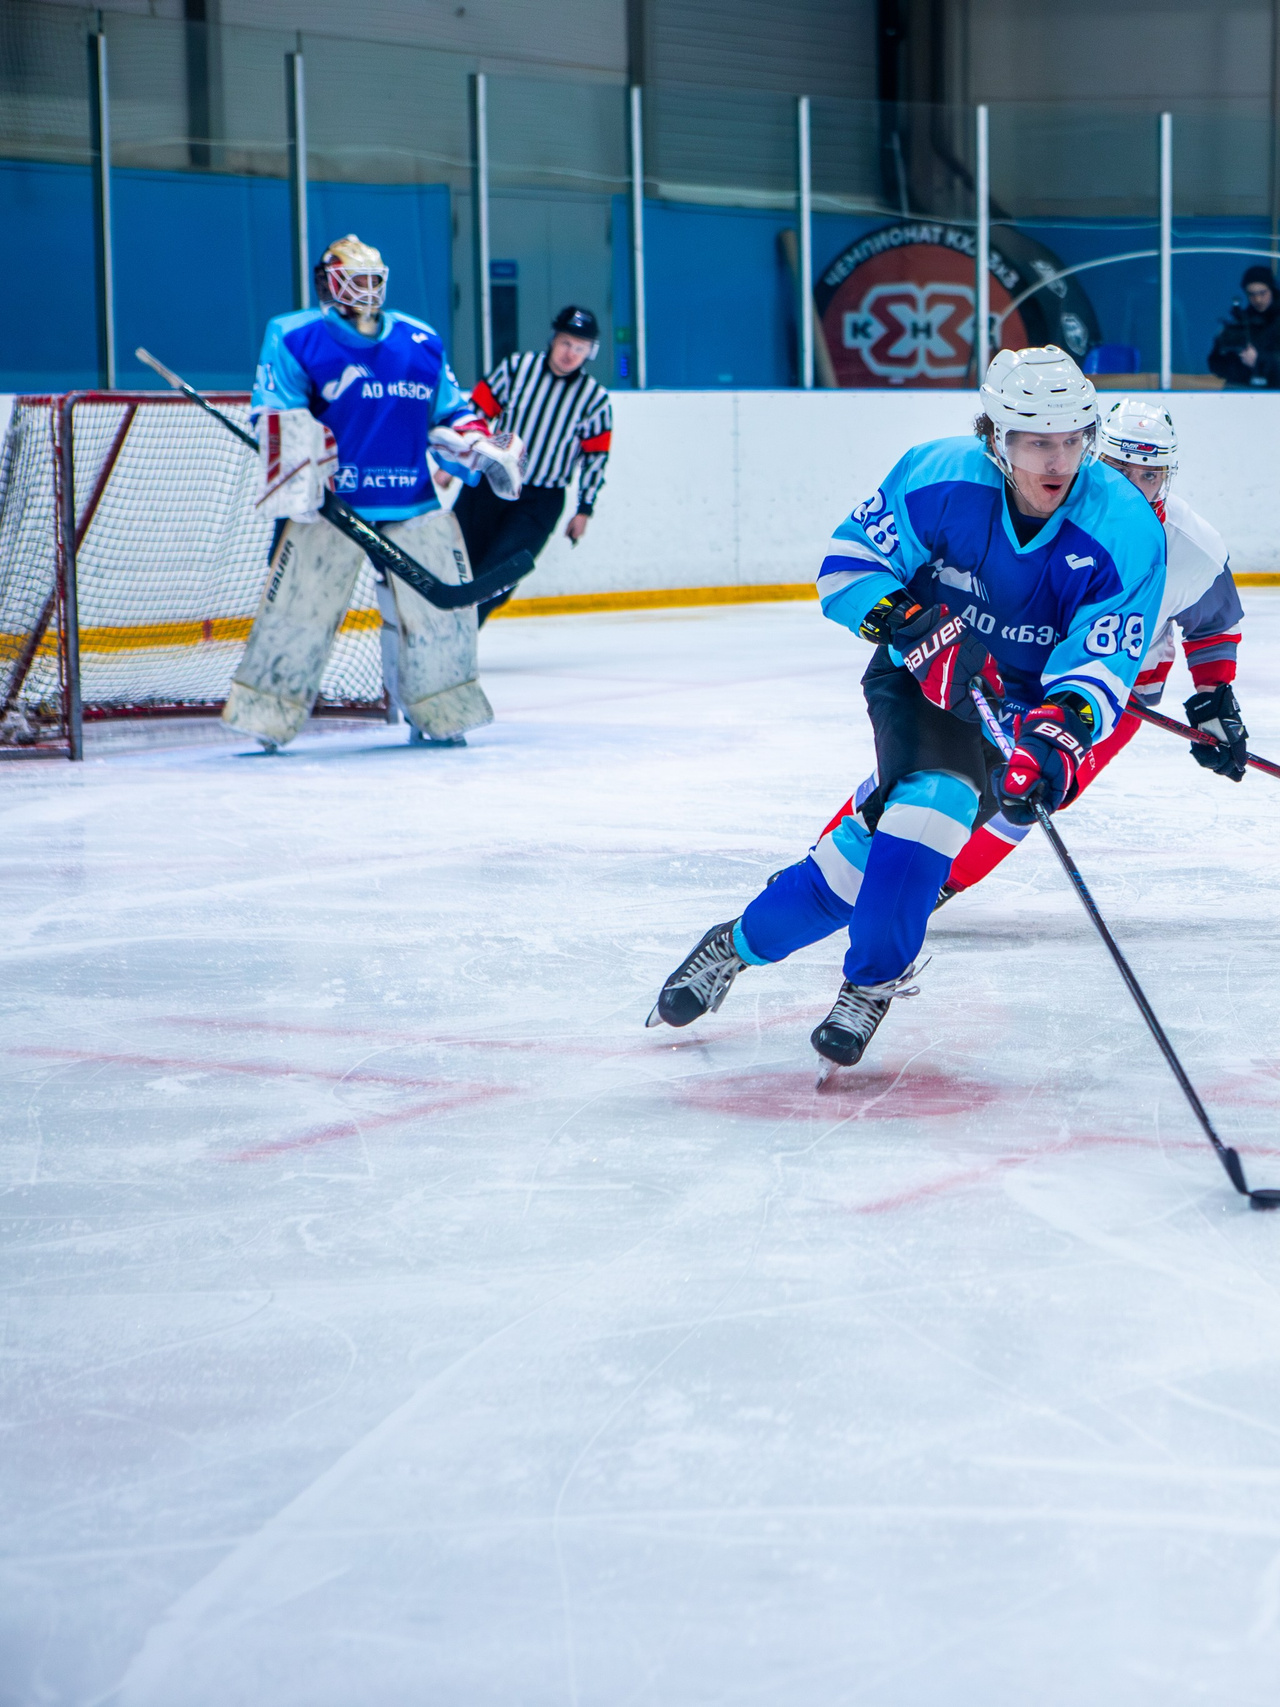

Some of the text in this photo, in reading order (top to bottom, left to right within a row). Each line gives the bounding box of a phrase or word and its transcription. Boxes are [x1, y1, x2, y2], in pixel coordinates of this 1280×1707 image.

[824, 226, 943, 287] ЧЕМПИОНАТ
[362, 382, 384, 399] АО
[267, 539, 294, 603] BAUER
[903, 616, 967, 673] BAUER
[961, 604, 1061, 648] АО «БЭ
[1083, 612, 1145, 662] 88
[1087, 749, 1096, 771] TEX
